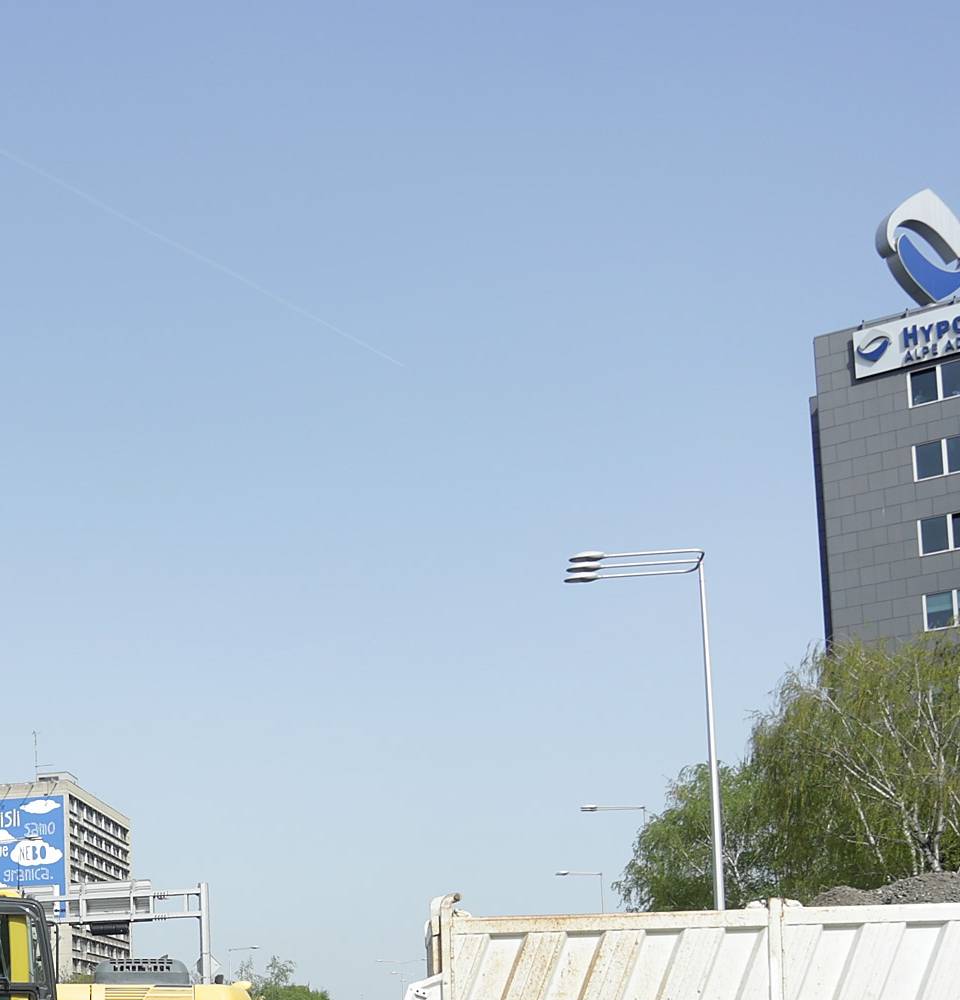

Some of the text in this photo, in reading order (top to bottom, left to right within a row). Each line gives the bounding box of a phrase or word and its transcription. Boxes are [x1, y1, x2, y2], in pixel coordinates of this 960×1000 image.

[904, 343, 938, 363] ALPE
[23, 821, 56, 837] samo
[19, 845, 47, 861] NEBO
[3, 867, 54, 882] granica.
